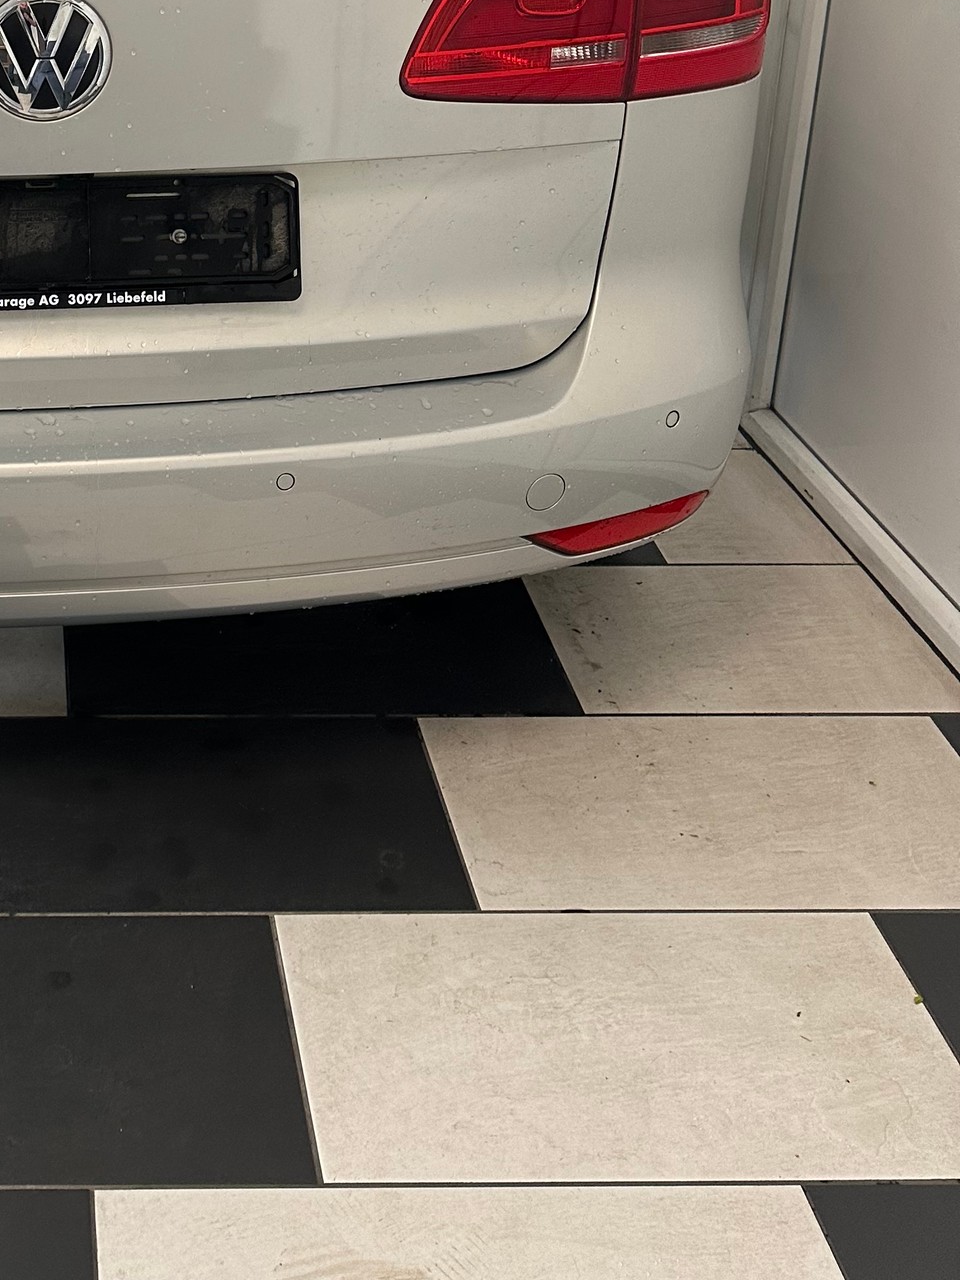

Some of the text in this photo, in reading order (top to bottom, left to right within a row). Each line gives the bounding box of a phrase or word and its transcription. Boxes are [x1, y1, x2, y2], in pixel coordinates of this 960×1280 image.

[38, 294, 60, 306] AG
[67, 293, 102, 305] 3097
[106, 290, 166, 304] Liebefeld
